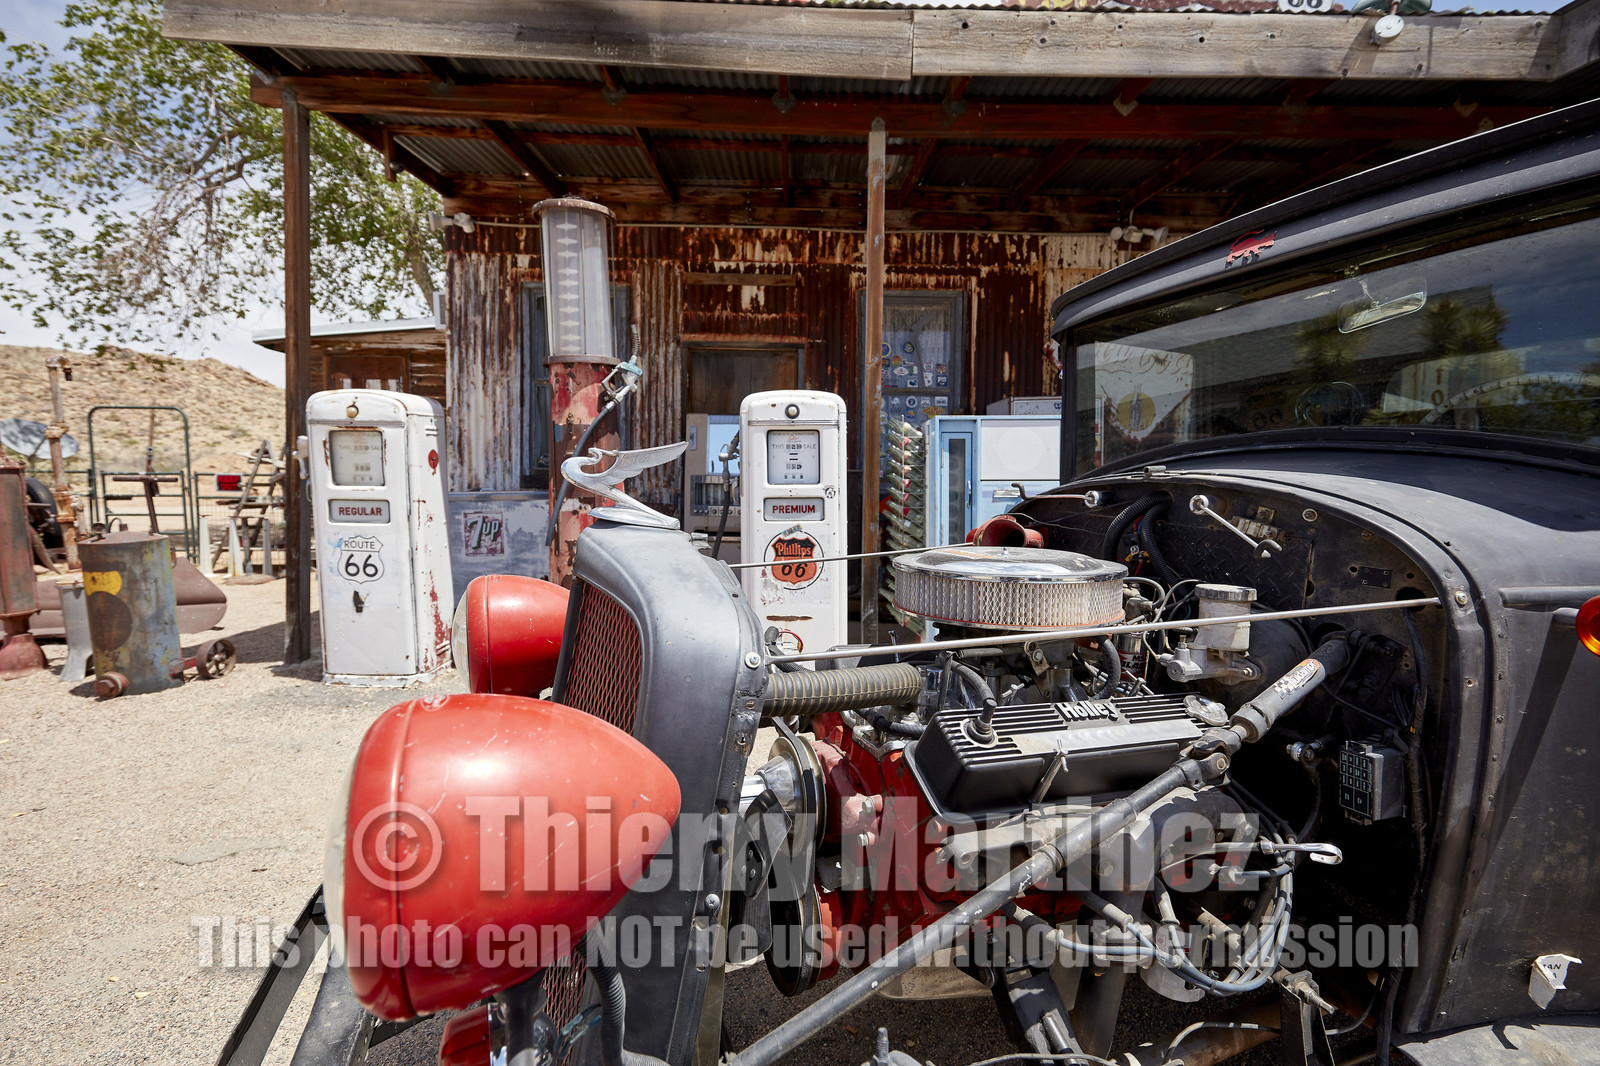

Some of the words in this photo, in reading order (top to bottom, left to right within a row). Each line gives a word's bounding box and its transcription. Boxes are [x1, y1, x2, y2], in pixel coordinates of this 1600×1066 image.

[338, 506, 382, 516] REGULAR
[772, 504, 816, 514] PREMIUM
[344, 540, 375, 549] ROUTE
[775, 542, 812, 559] Phillips
[345, 553, 379, 577] 66
[781, 561, 808, 578] 66
[1054, 700, 1119, 722] Holley
